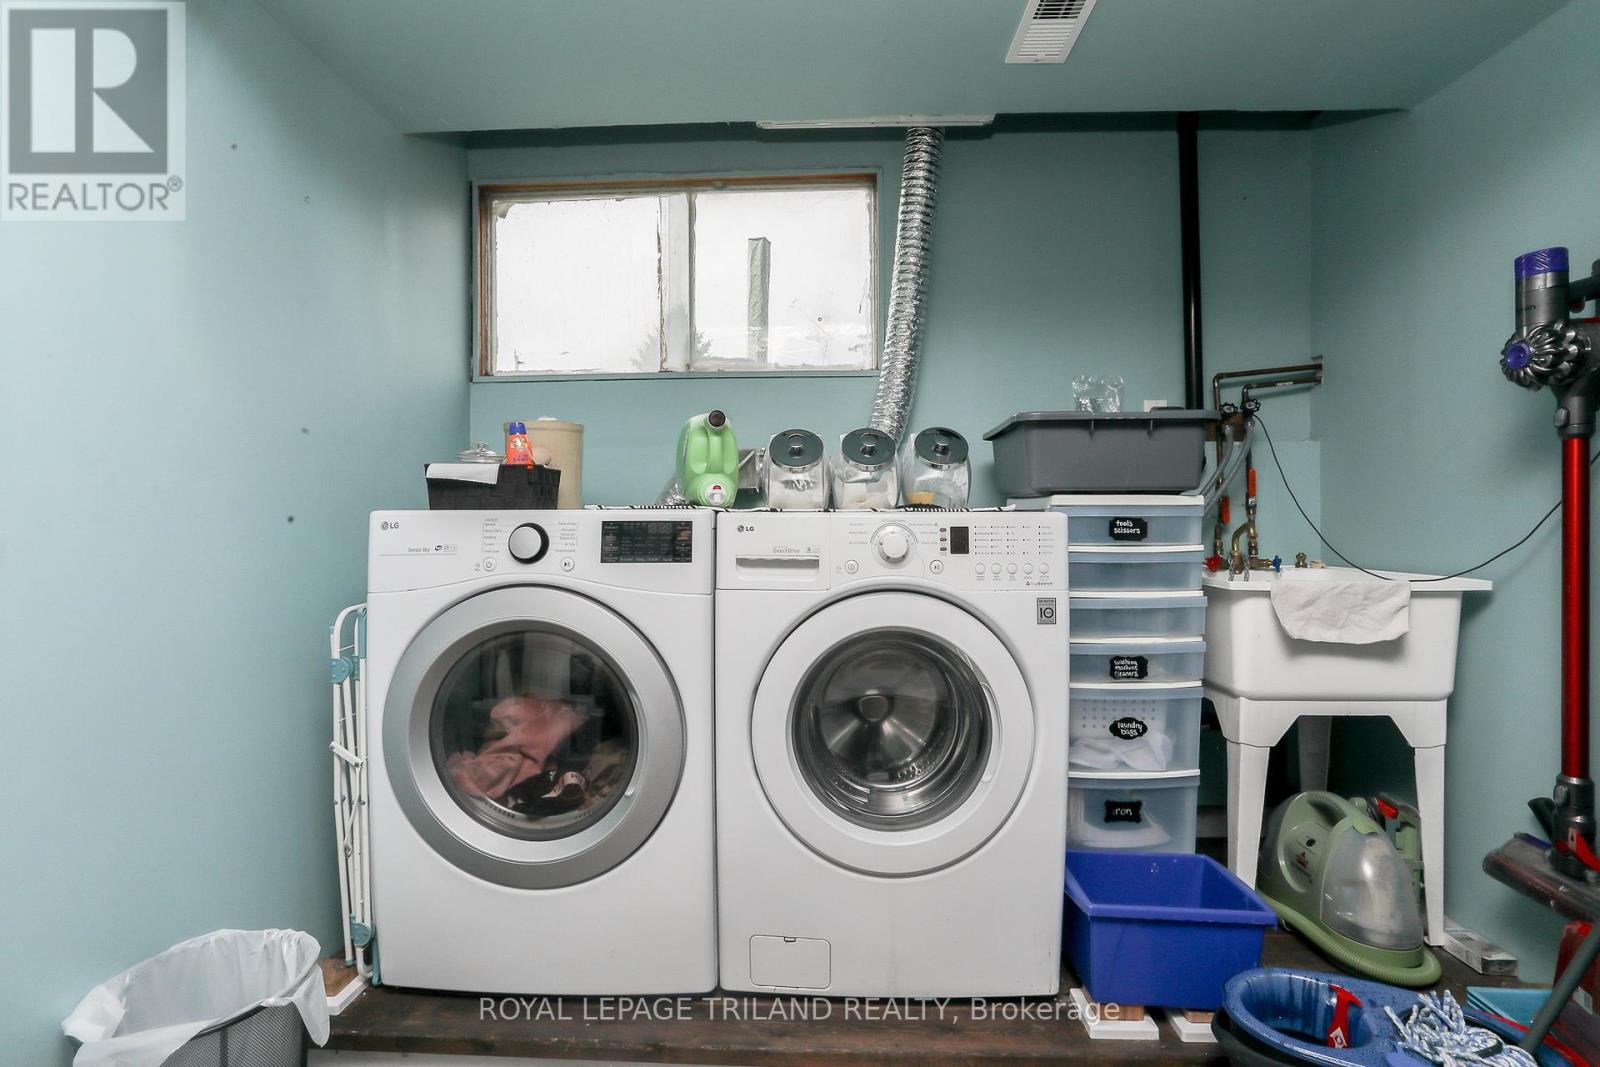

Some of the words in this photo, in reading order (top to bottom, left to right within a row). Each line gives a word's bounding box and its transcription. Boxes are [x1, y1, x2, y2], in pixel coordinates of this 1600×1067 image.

[1115, 519, 1134, 527] tools
[1039, 607, 1054, 619] 10
[1117, 721, 1143, 733] laundry
[1120, 728, 1138, 737] bags
